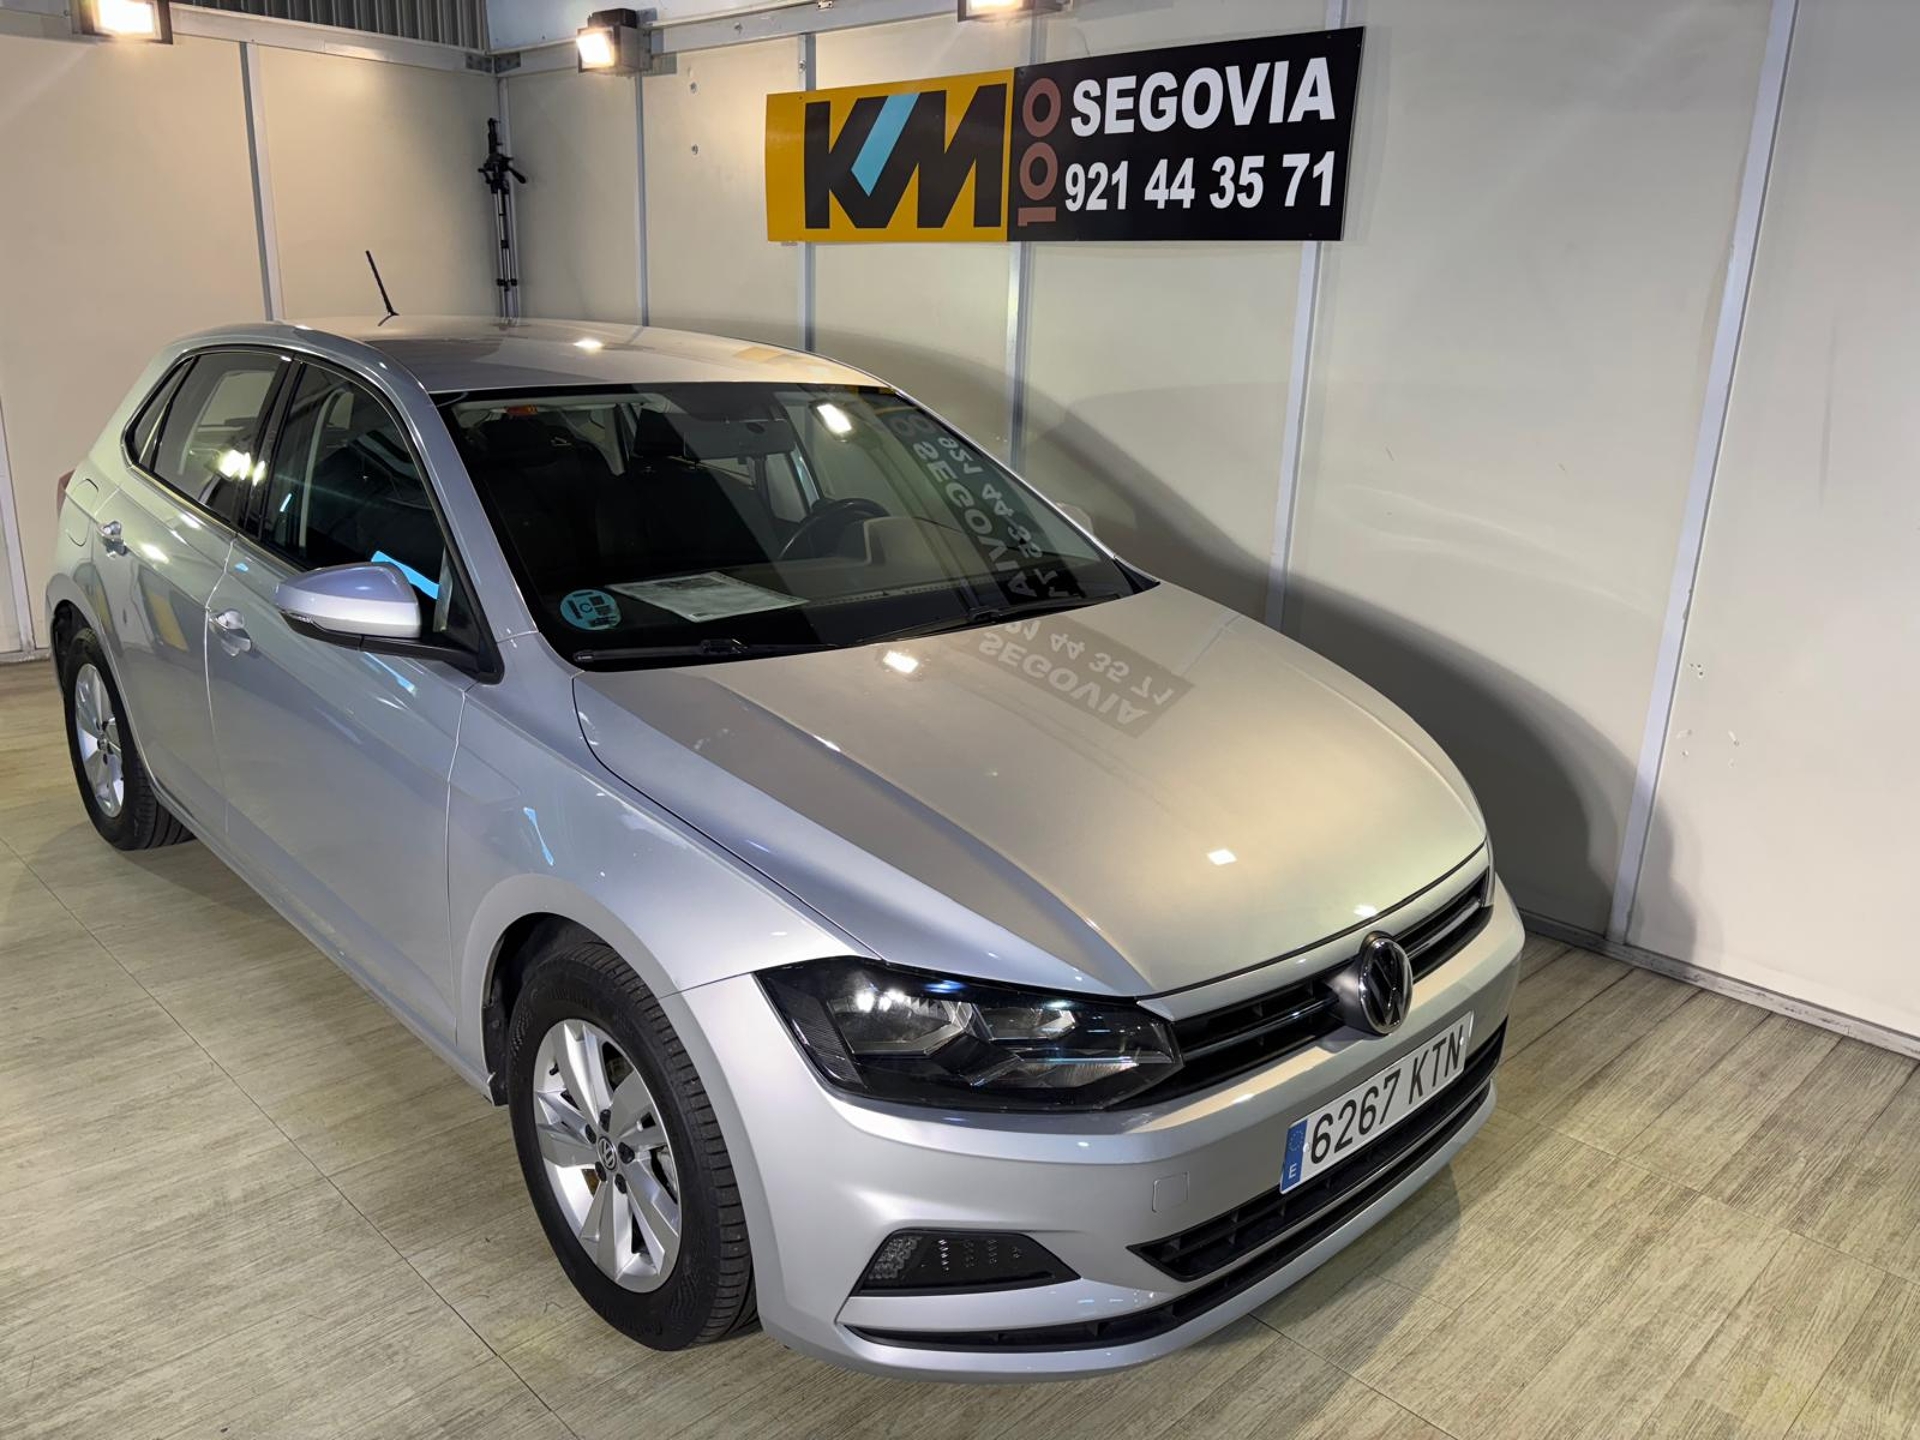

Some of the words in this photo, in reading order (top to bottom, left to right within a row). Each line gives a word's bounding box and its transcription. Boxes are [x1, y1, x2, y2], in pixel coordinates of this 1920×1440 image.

[1071, 57, 1335, 137] SEGOVIA
[803, 84, 1008, 229] KM
[1017, 78, 1062, 227] 100
[1065, 160, 1129, 212] 921
[1144, 157, 1195, 208] 44
[1210, 156, 1264, 209] 35
[1282, 151, 1332, 207] 71
[1310, 1068, 1401, 1164] 6267
[1409, 1025, 1464, 1105] KTN
[1288, 1163, 1297, 1179] E
